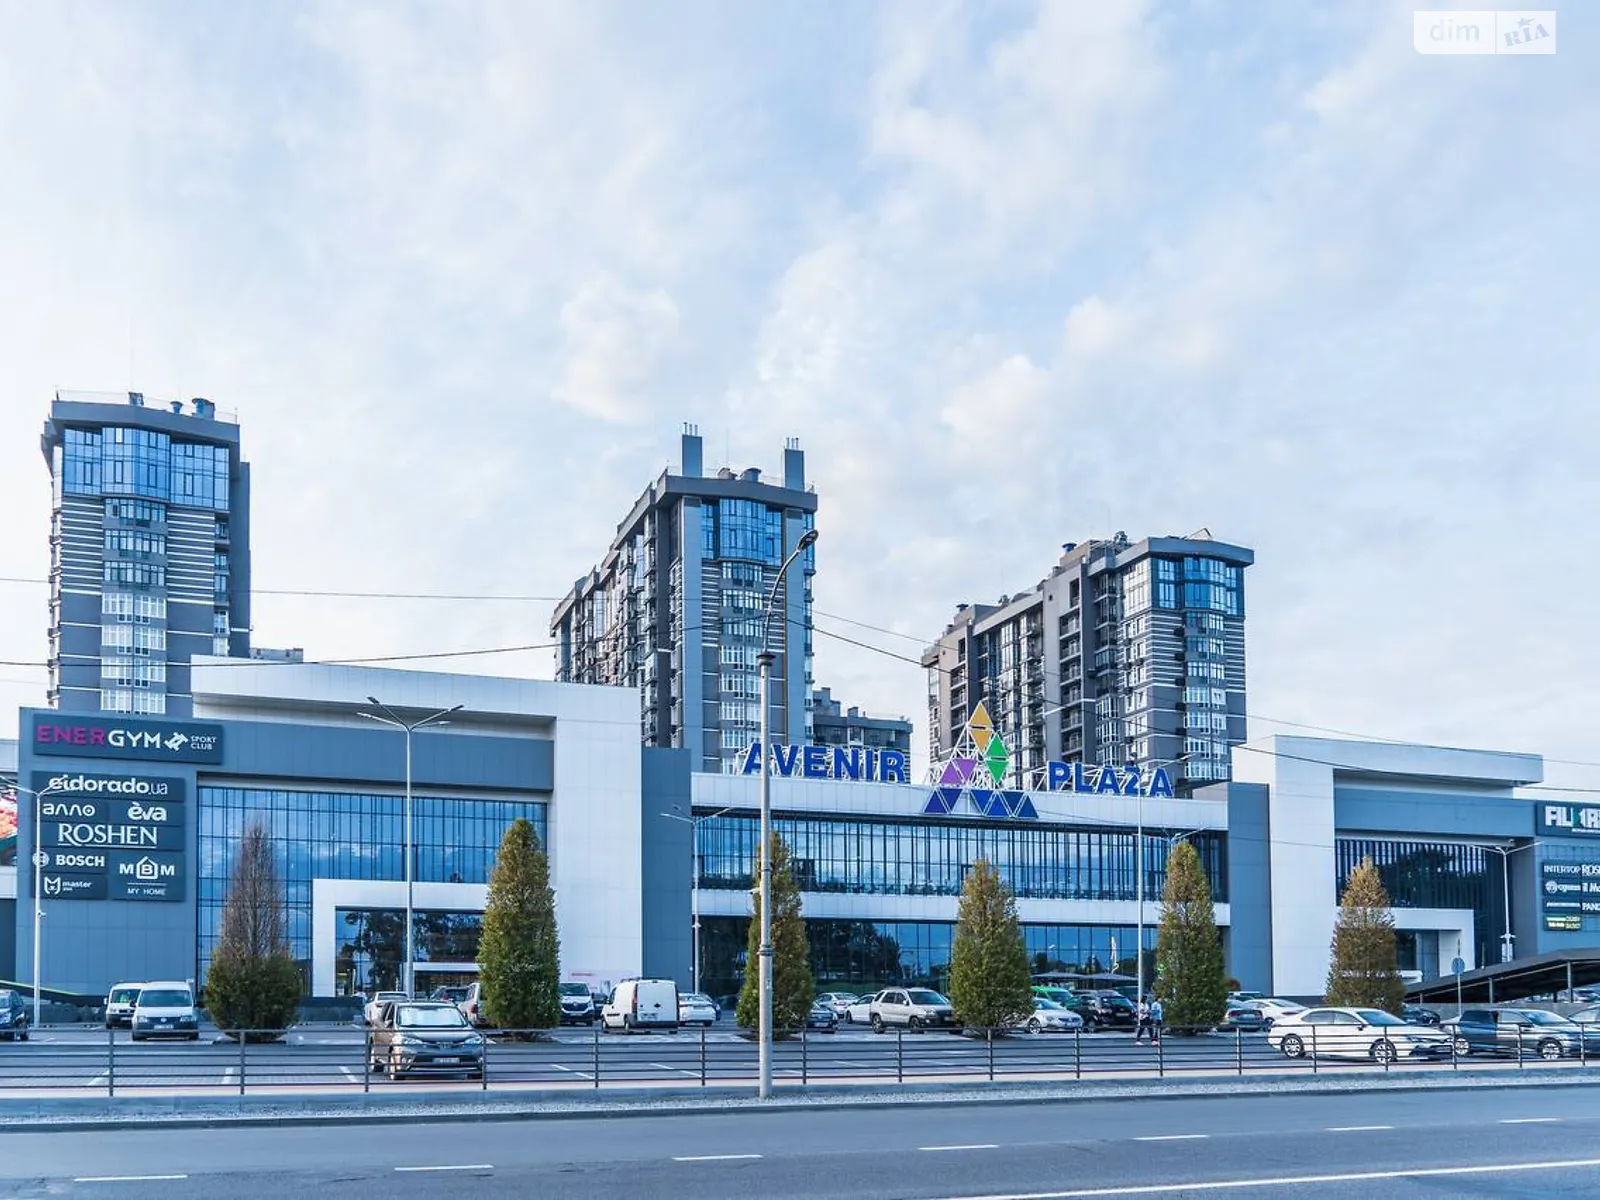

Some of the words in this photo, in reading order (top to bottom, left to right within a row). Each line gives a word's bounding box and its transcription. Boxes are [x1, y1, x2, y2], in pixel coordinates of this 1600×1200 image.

[190, 734, 217, 744] SPORT
[190, 742, 213, 751] CLUB
[741, 742, 907, 785] AVENIR
[1046, 760, 1174, 799] PLAZA
[57, 823, 158, 847] ROSHEN
[55, 854, 105, 867] BOSCH
